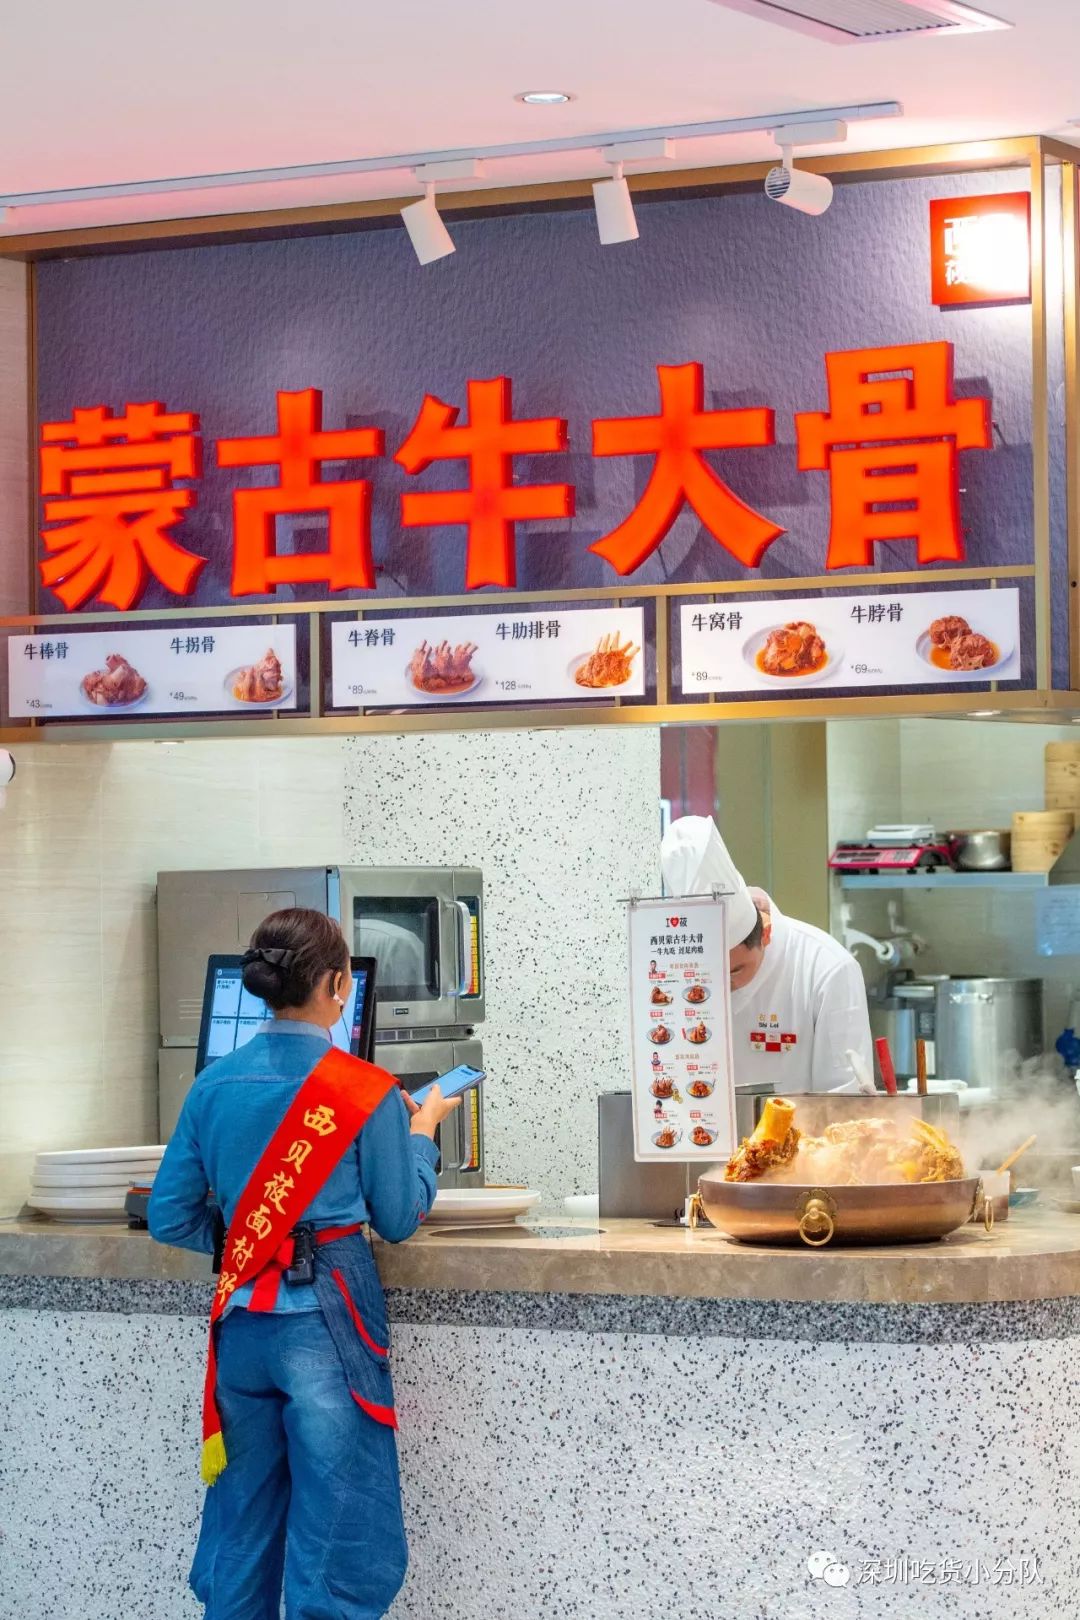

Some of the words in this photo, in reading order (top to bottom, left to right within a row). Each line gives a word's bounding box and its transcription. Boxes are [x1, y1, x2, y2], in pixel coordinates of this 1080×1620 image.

[39, 341, 992, 611] 蒙古牛大骨
[691, 611, 743, 632] 牛窝骨
[850, 602, 904, 624] 牛脖骨
[348, 627, 396, 647] 牛脊骨
[495, 620, 561, 640] 牛肋排骨
[24, 641, 69, 660] 牛棒骨
[170, 635, 216, 655] 牛拐骨
[650, 933, 703, 945] 西贝蒙古牛大骨
